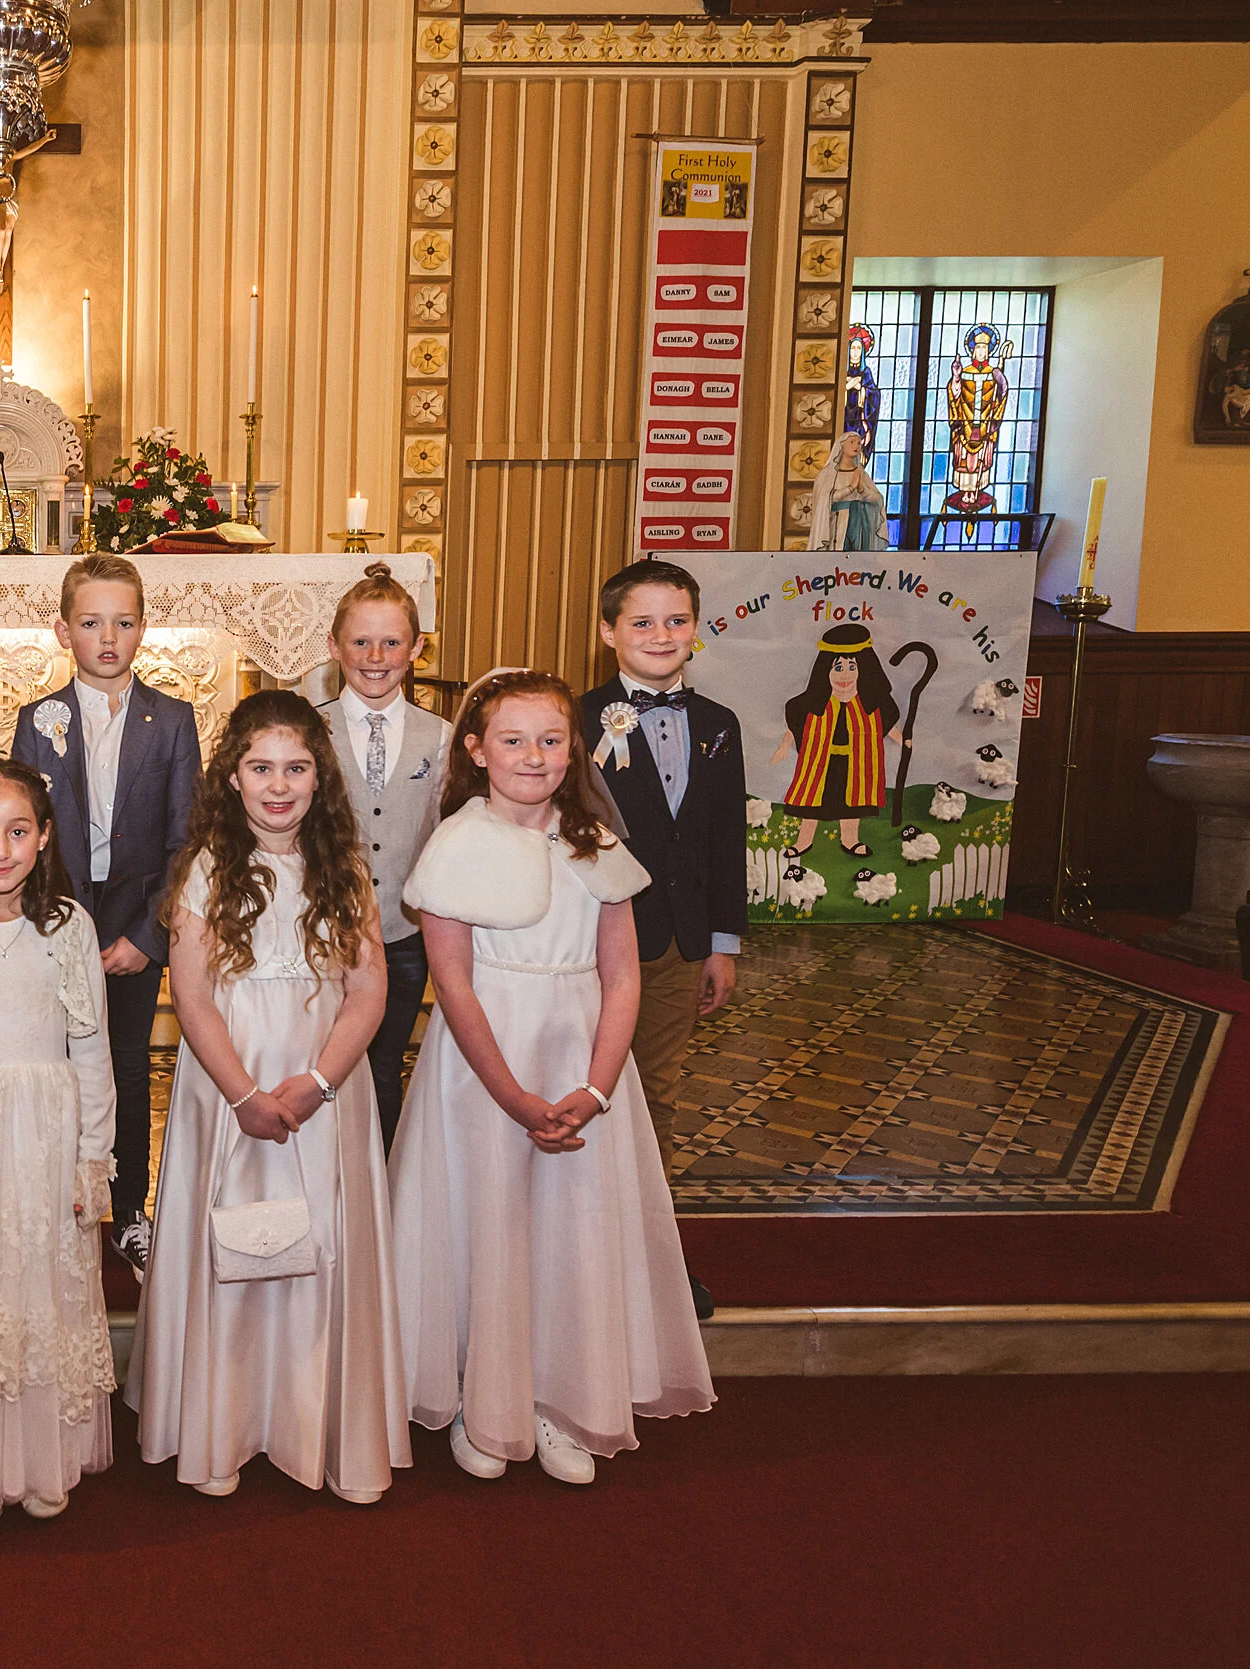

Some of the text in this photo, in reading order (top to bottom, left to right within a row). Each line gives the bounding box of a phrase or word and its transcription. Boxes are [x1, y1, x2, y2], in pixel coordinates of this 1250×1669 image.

[678, 153, 737, 169] First Holy
[670, 168, 741, 183] Communion
[694, 189, 712, 197] 2021
[651, 480, 681, 488] CIARÁN
[707, 617, 728, 636] is
[735, 592, 771, 620] our
[898, 569, 929, 597] We
[938, 591, 977, 622] are
[971, 625, 1001, 664] his
[812, 601, 874, 621] flock
